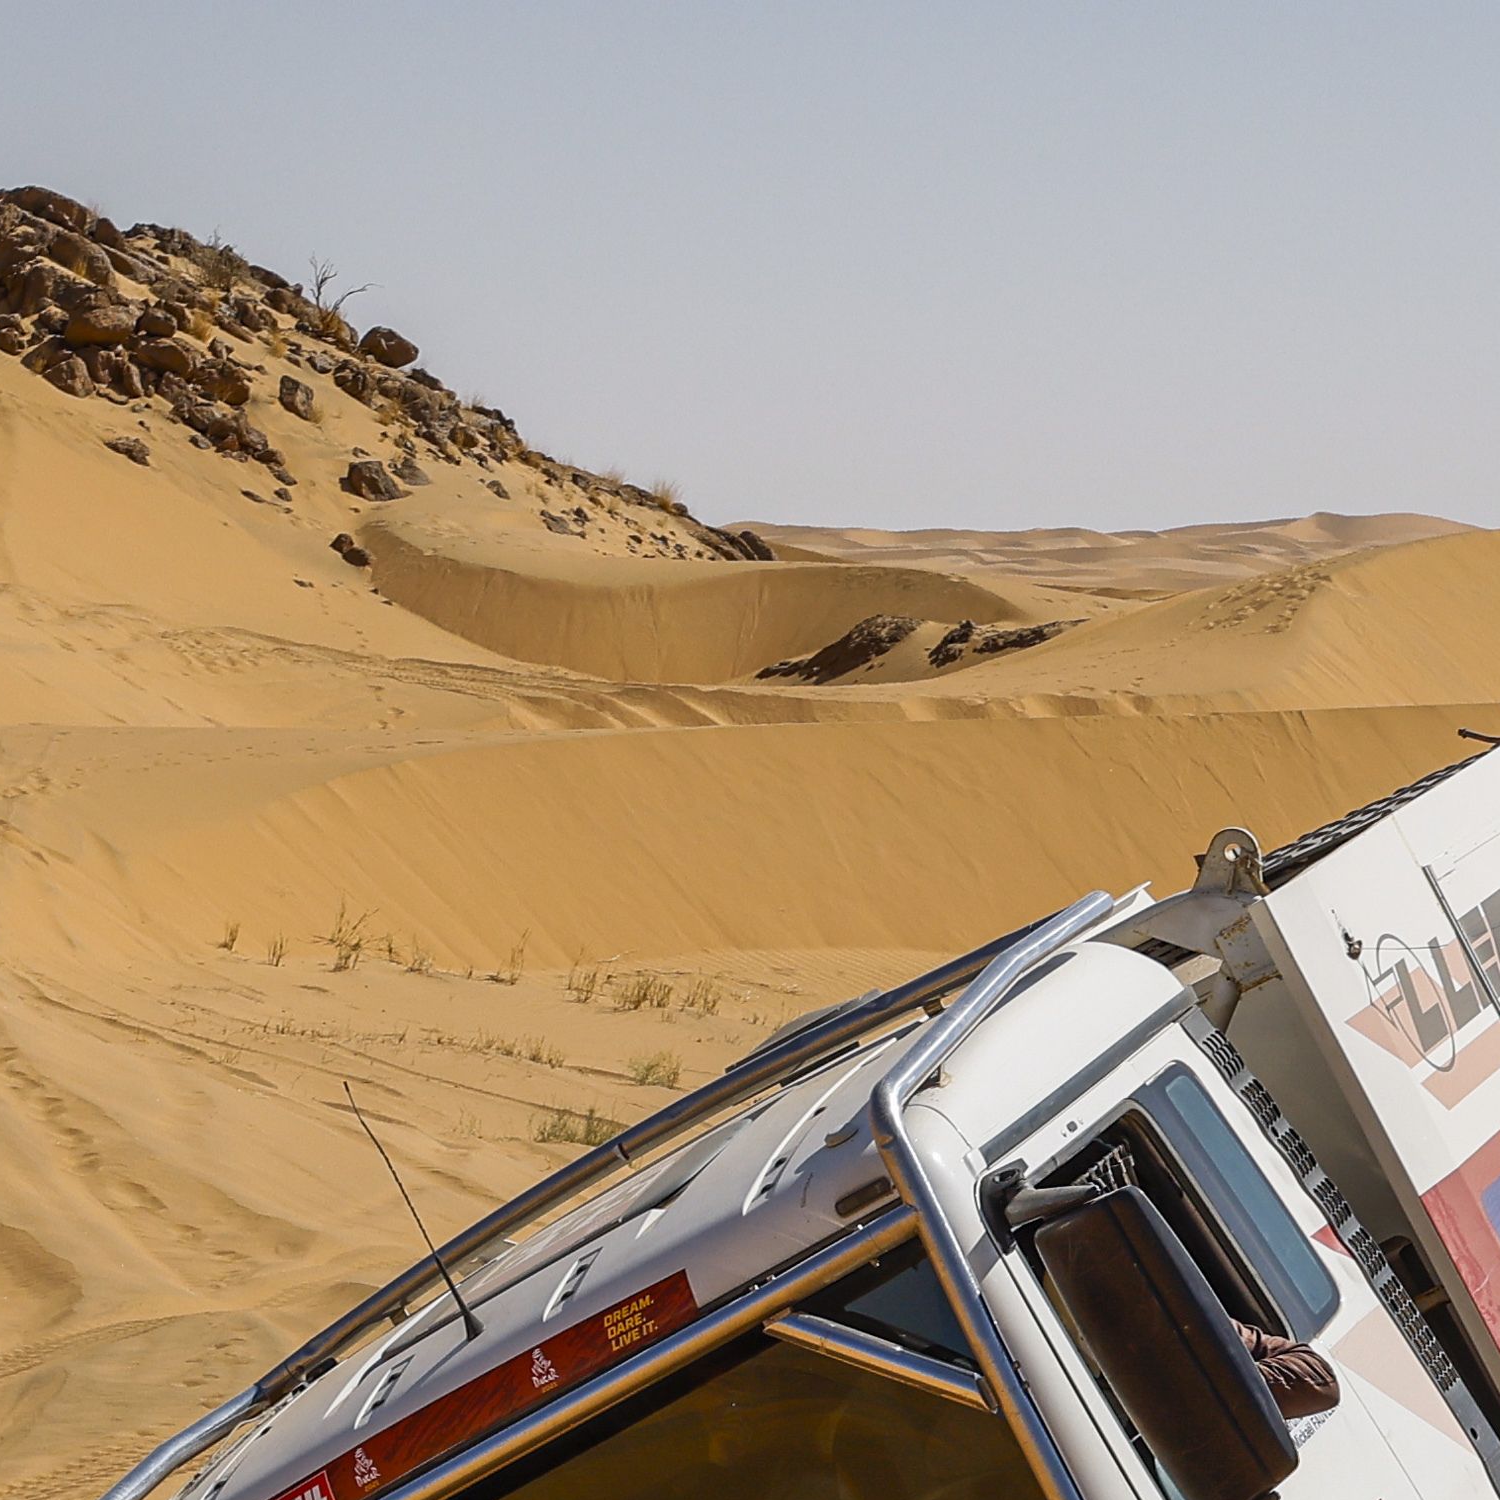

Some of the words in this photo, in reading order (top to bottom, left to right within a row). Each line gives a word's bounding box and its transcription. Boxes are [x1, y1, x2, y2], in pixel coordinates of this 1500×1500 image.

[604, 1295, 654, 1327] DREAM.
[607, 1313, 646, 1339] DARE.
[611, 1328, 640, 1351] LIVE
[642, 1320, 658, 1337] IT.
